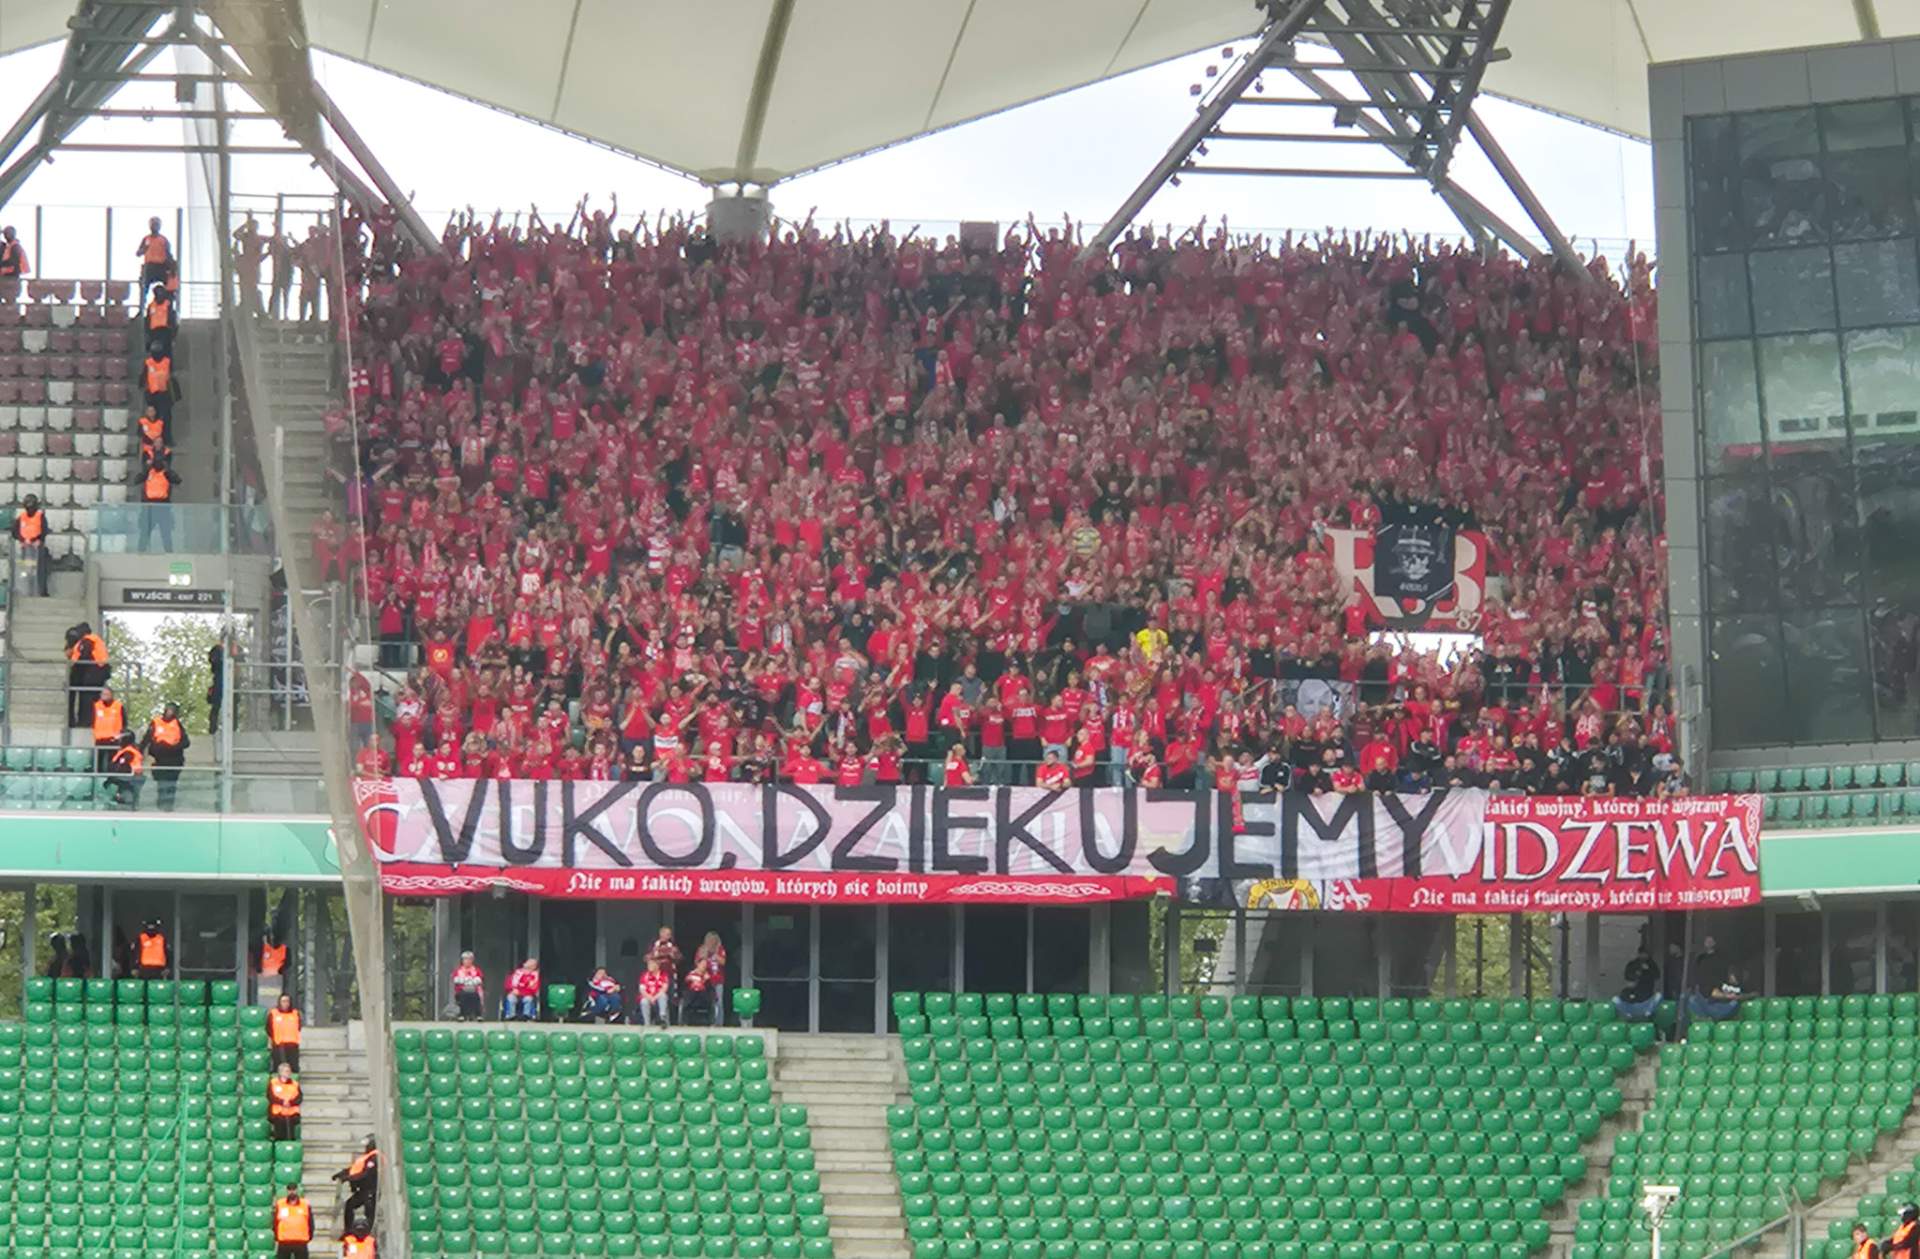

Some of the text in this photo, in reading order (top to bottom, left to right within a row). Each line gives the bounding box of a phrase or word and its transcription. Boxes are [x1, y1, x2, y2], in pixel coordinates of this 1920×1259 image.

[130, 591, 171, 601] WYJŚCIE
[1535, 796, 1588, 818] wojny,
[1593, 797, 1640, 816] której
[1645, 799, 1669, 814] nie
[566, 872, 928, 899] Nie ma takich wrogów, których się boimy
[1409, 887, 1445, 908] Nie
[1451, 890, 1477, 905] ma
[1484, 888, 1529, 907] takiej
[1534, 888, 1605, 909] twierdzy,
[1609, 889, 1655, 905] której
